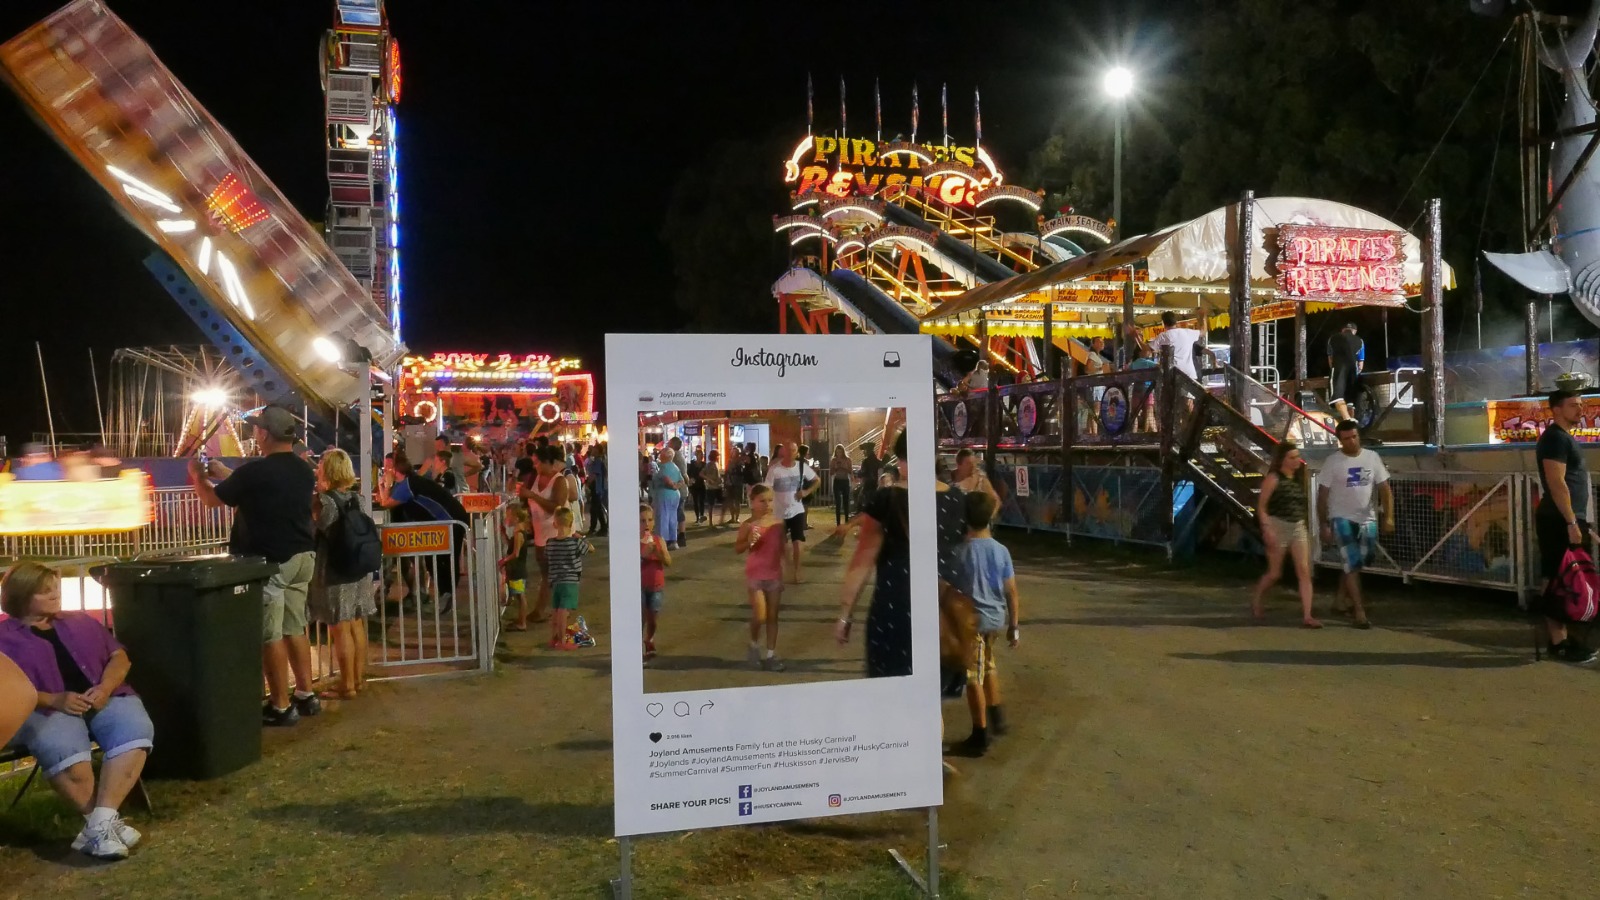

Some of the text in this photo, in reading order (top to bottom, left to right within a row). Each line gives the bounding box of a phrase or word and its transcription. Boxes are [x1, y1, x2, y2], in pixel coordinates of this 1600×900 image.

[867, 227, 900, 240] WELCOME
[1040, 218, 1070, 232] REMAIN
[1293, 235, 1396, 265] PIRATES
[1291, 264, 1401, 295] REVENGE
[1088, 295, 1118, 303] ADULTS!
[731, 347, 818, 377] Instagram
[387, 530, 446, 548] NO ENTRY
[649, 748, 681, 759] Joyland
[682, 745, 734, 755] Amusements
[735, 743, 760, 751] Family
[799, 738, 823, 746] Husky
[824, 735, 857, 744] Carnival!
[649, 741, 909, 768] #Joylands #JoylandAmusements #HuskissonCarnival #HuskyCarnival
[649, 755, 859, 779] #SummerCarnival #SummerFun #Huskisson #JervisBay
[650, 797, 731, 811] SHARE YOUR PICS!
